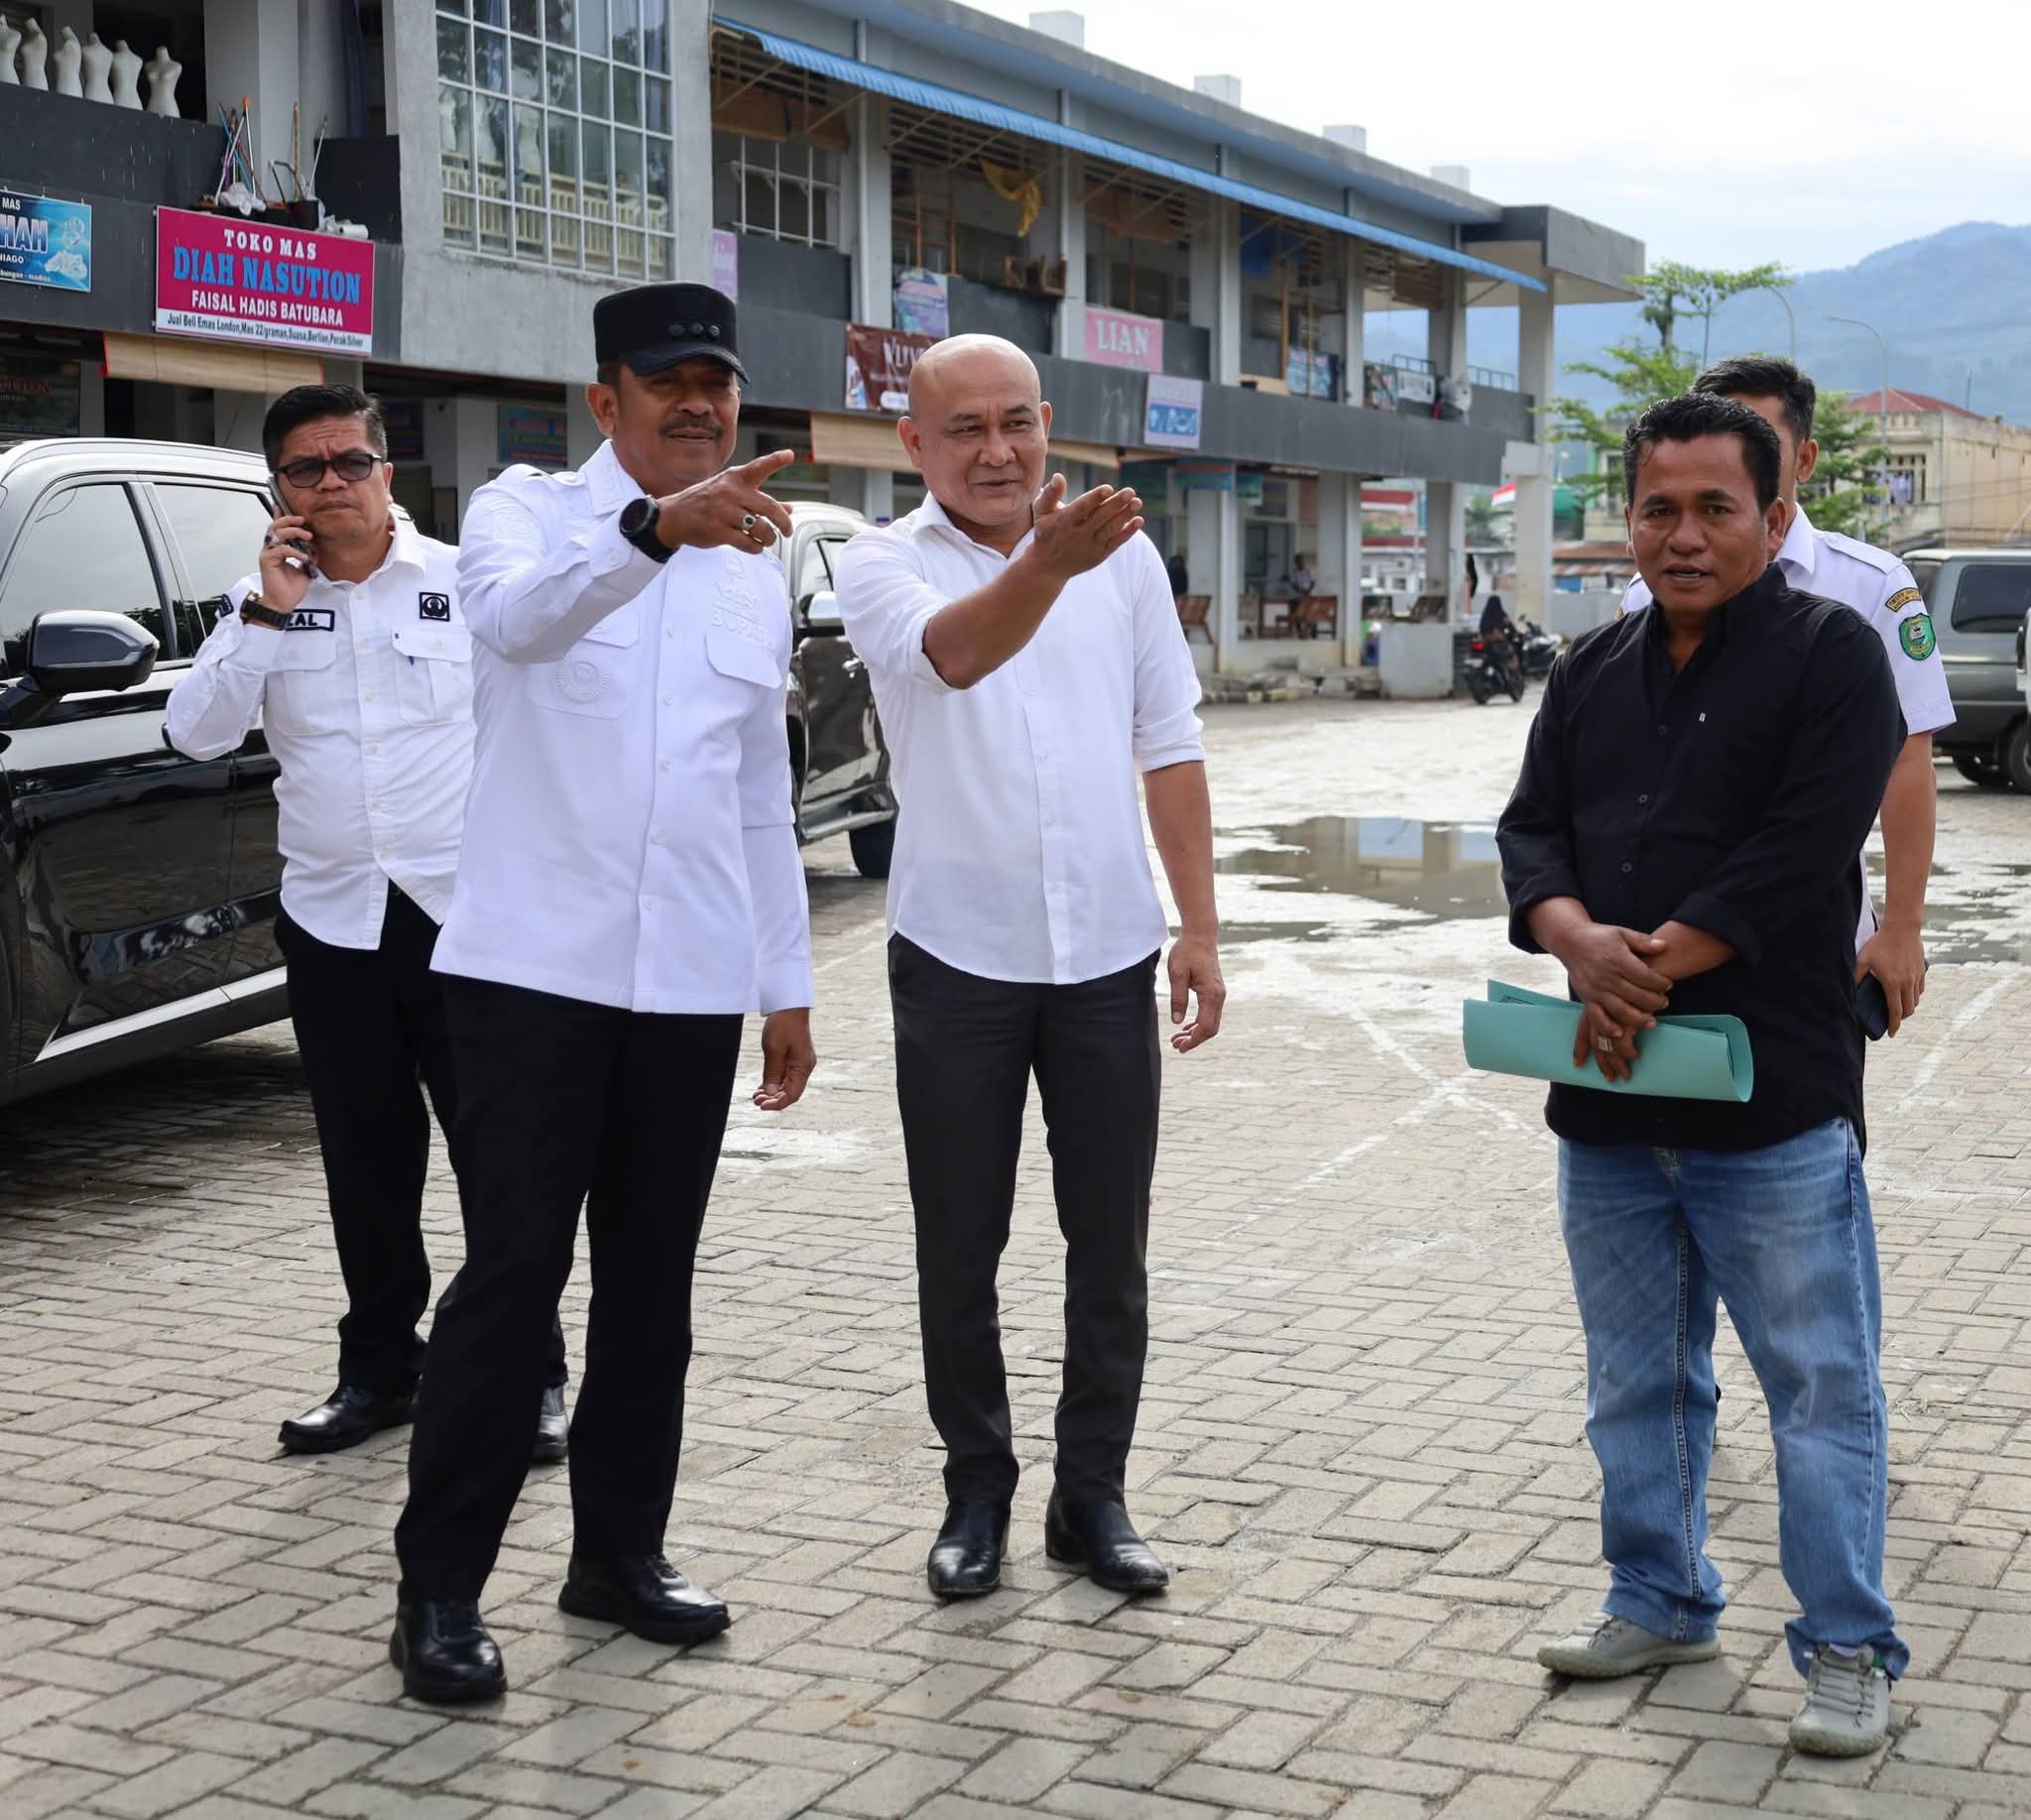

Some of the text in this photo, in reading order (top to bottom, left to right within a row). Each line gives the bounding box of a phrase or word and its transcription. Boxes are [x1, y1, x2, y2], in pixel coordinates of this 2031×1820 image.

[2, 197, 21, 210] MAS
[224, 229, 316, 260] TOKO MAS
[174, 247, 361, 304] DIAH NASUTION
[168, 312, 182, 325] Jual
[197, 316, 216, 330] Emas
[191, 290, 344, 326] FAISAL HADIS BATUBARA
[1097, 319, 1149, 356] LIAN
